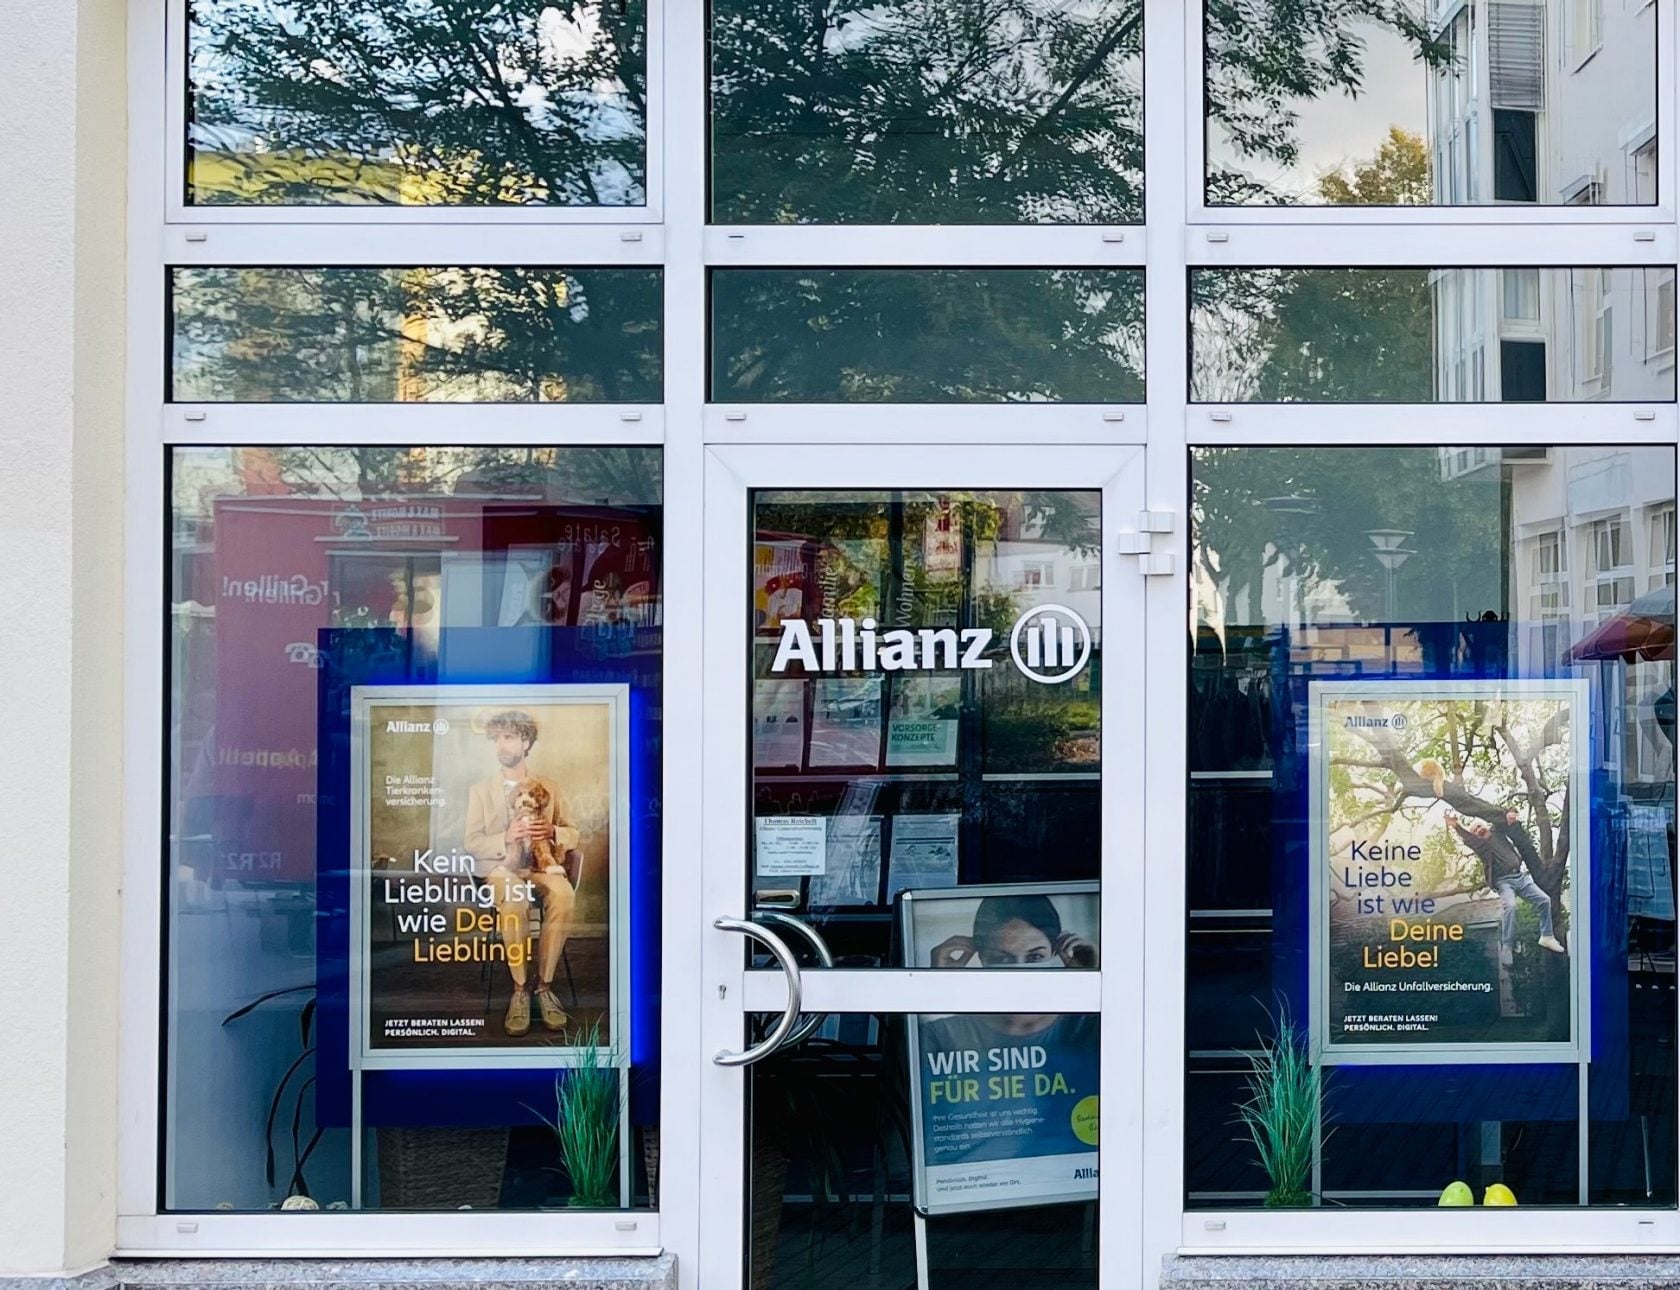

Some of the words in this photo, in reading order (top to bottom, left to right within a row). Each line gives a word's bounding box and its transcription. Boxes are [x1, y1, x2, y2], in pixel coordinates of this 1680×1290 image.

[819, 566, 838, 620] amilie
[896, 559, 917, 627] Wohnen
[771, 618, 993, 672] Allianz
[386, 720, 431, 733] Allianz
[892, 723, 940, 734] VORSORGE-
[1344, 715, 1388, 728] Allianz
[891, 733, 936, 743] KONZEPTE
[385, 775, 402, 785] Die
[403, 775, 435, 785] Allianz
[385, 786, 446, 796] Tierkranken-
[414, 849, 475, 873] Kein
[1351, 840, 1421, 861] Keine
[1344, 866, 1412, 888] Liebe
[384, 879, 495, 907] Liebling
[505, 880, 536, 903] ist
[1357, 893, 1384, 914] ist
[1391, 895, 1436, 914] wie
[397, 910, 447, 933] wie
[455, 907, 520, 932] Dein
[1390, 919, 1464, 941] Deine
[414, 937, 532, 966] Liebling!
[1363, 945, 1439, 968] Liebe!
[1344, 981, 1361, 992] Die
[1362, 981, 1397, 992] Allianz
[1398, 981, 1494, 994] Unfallversicherung.
[385, 1019, 408, 1027] JETZT
[411, 1019, 448, 1027] BERATEN
[450, 1019, 485, 1027] LASSEN!
[1344, 1015, 1366, 1023] JETZT
[1368, 1015, 1404, 1023] BERATEN
[1405, 1015, 1438, 1023] LASSEN!
[1397, 1023, 1429, 1031] DIGITAL.
[385, 1028, 440, 1037] PERSÖNLICH.
[442, 1028, 476, 1037] DIGITAL.
[927, 1050, 980, 1076] WIR
[987, 1045, 1047, 1072] SIND
[930, 1074, 980, 1105] FÜR
[988, 1075, 1026, 1100] SIE
[1035, 1072, 1076, 1097] DA.
